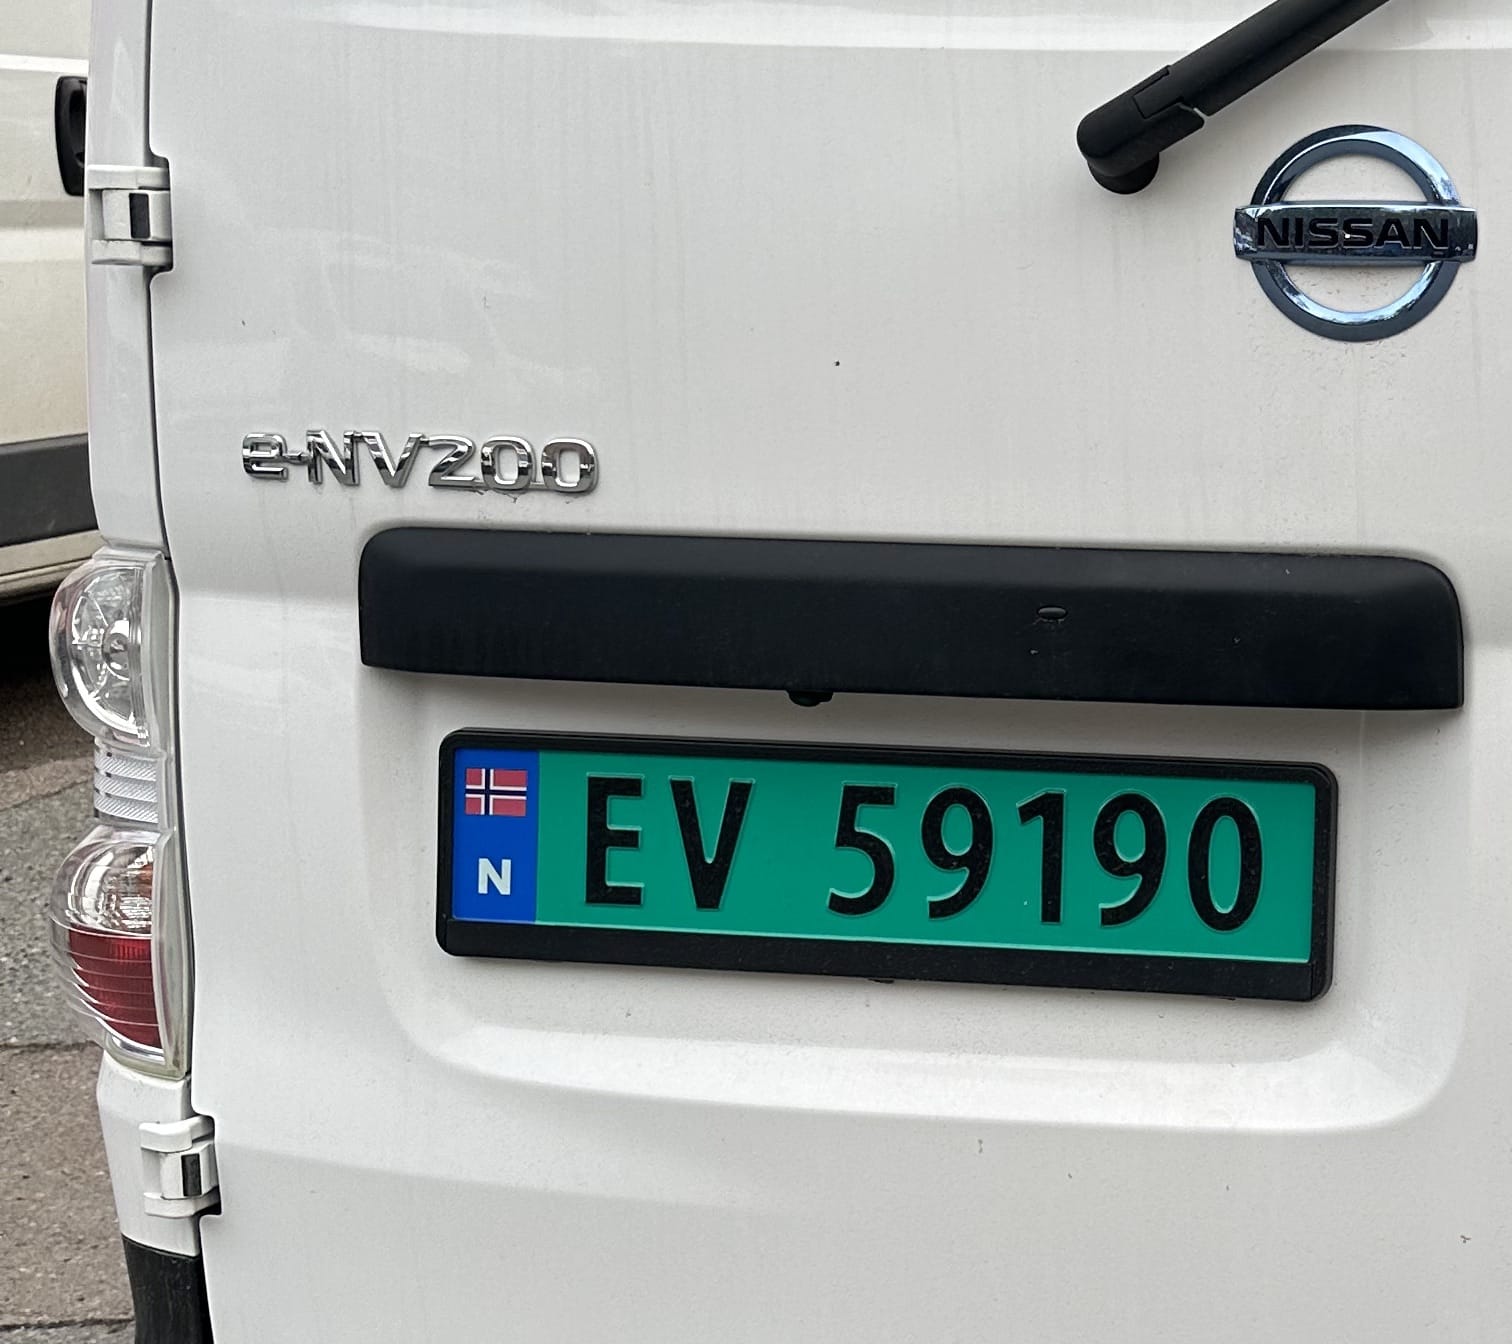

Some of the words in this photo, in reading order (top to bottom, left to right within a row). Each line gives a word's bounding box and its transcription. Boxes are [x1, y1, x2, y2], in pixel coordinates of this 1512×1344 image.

[1257, 217, 1449, 250] NISSAN
[242, 429, 599, 493] e-NV200
[477, 858, 512, 895] N
[584, 774, 755, 909] EV
[827, 783, 1264, 932] 59190
